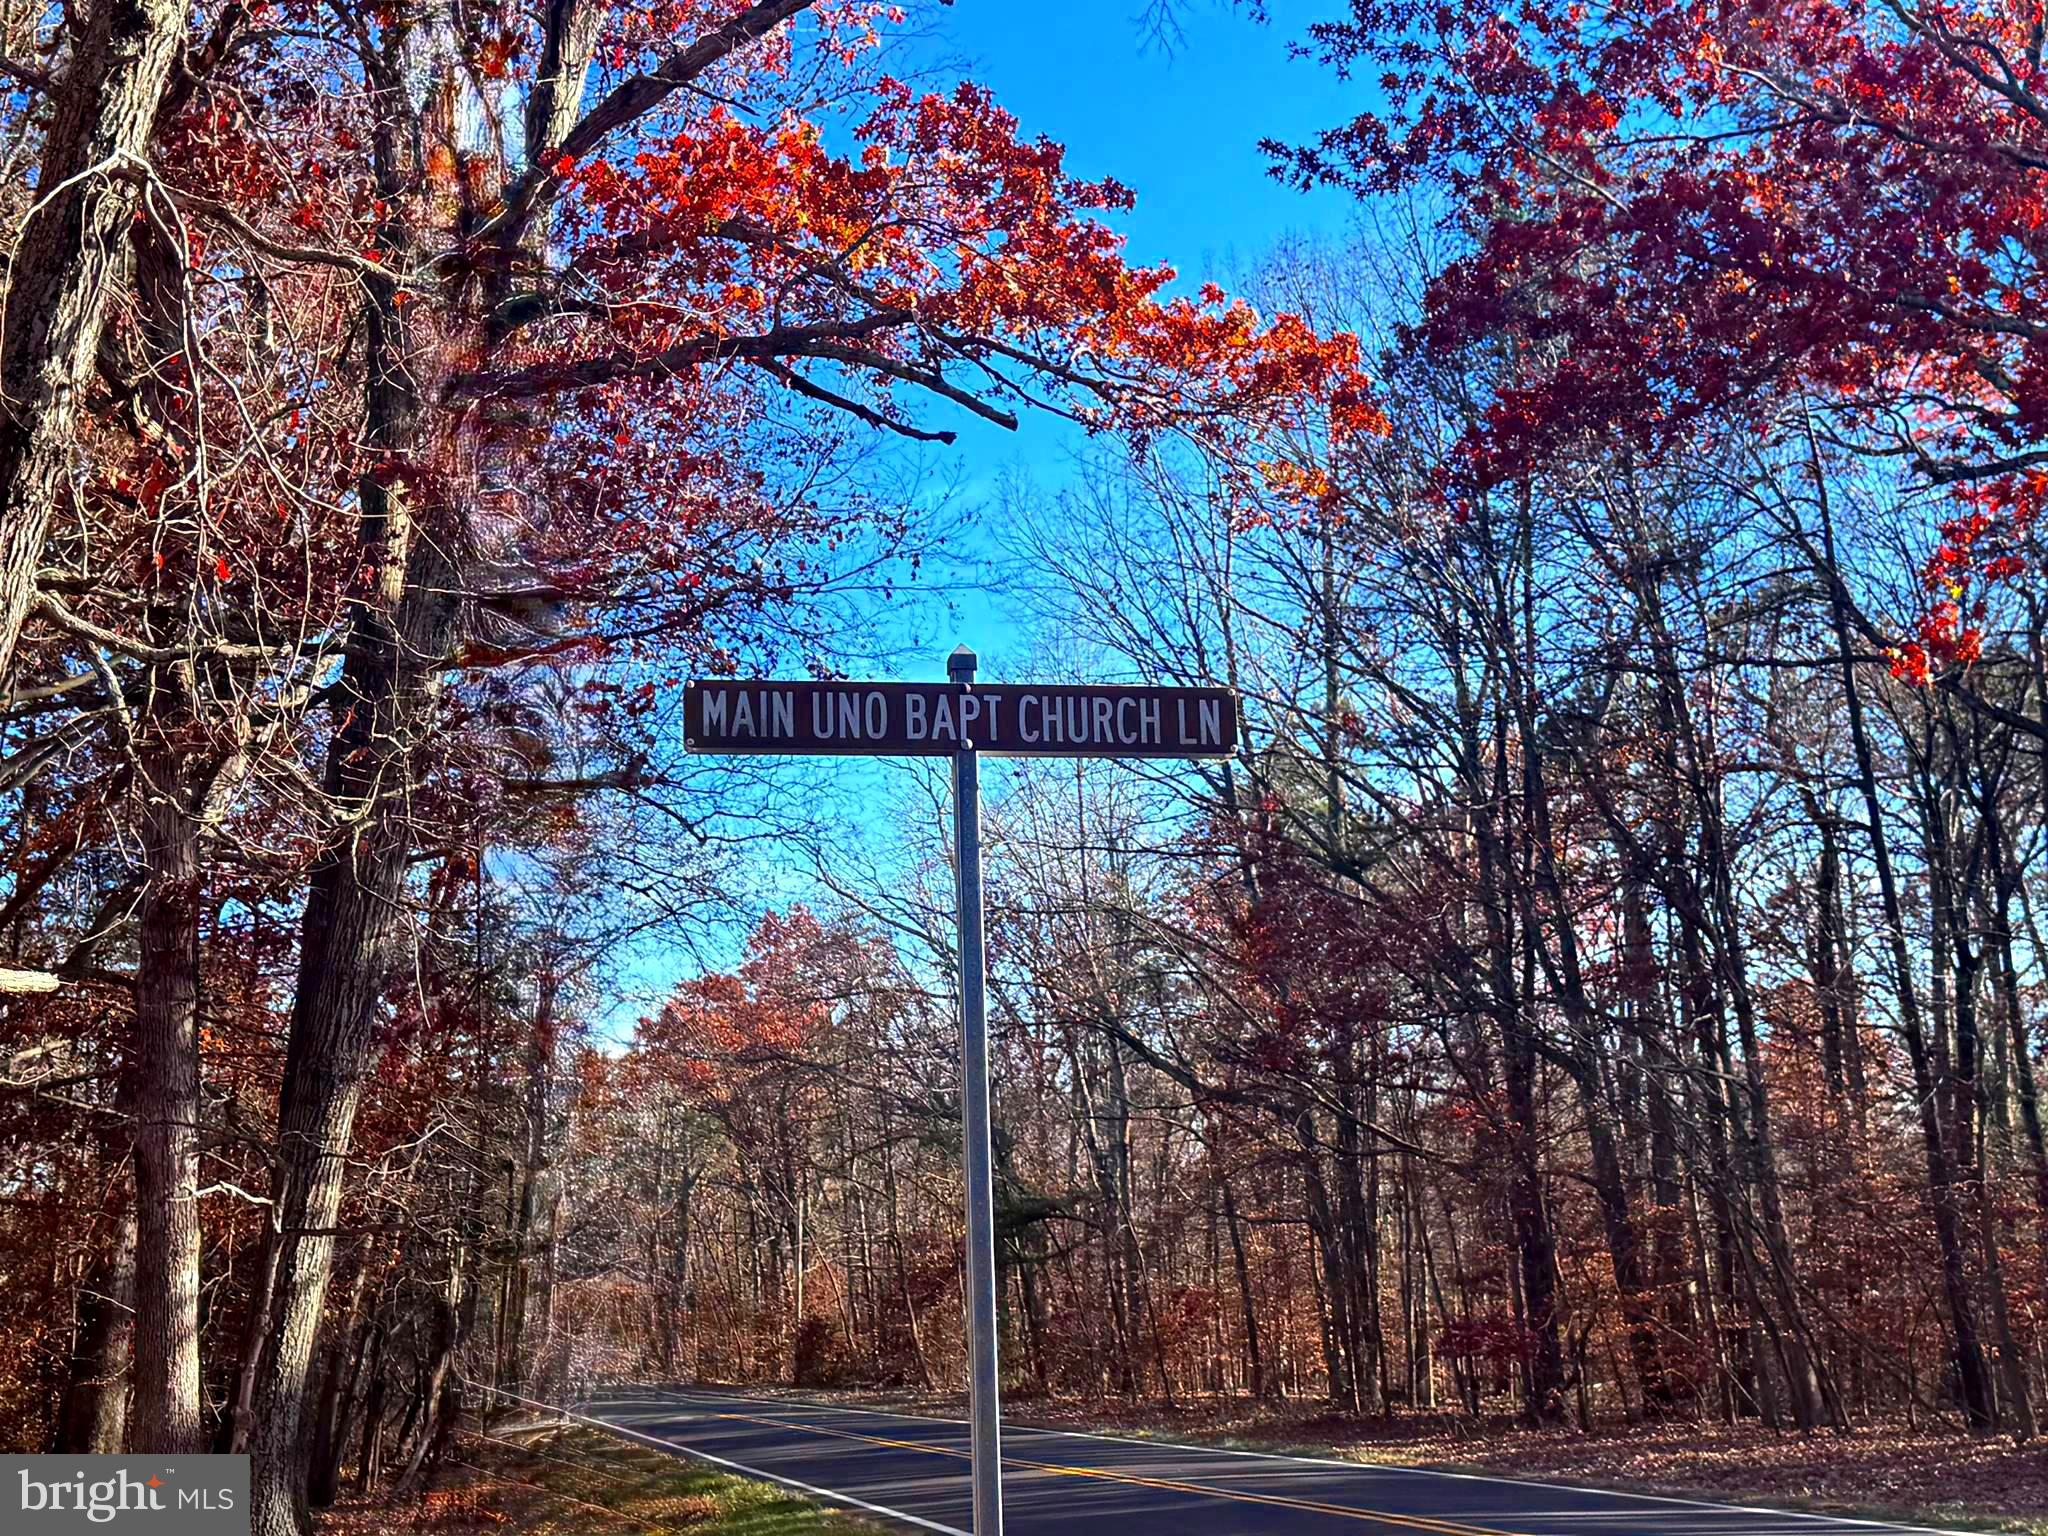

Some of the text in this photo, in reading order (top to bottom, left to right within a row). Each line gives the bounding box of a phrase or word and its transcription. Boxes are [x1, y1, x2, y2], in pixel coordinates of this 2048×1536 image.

[702, 690, 1221, 745] MAIN UNO BAPT CHURCH LN
